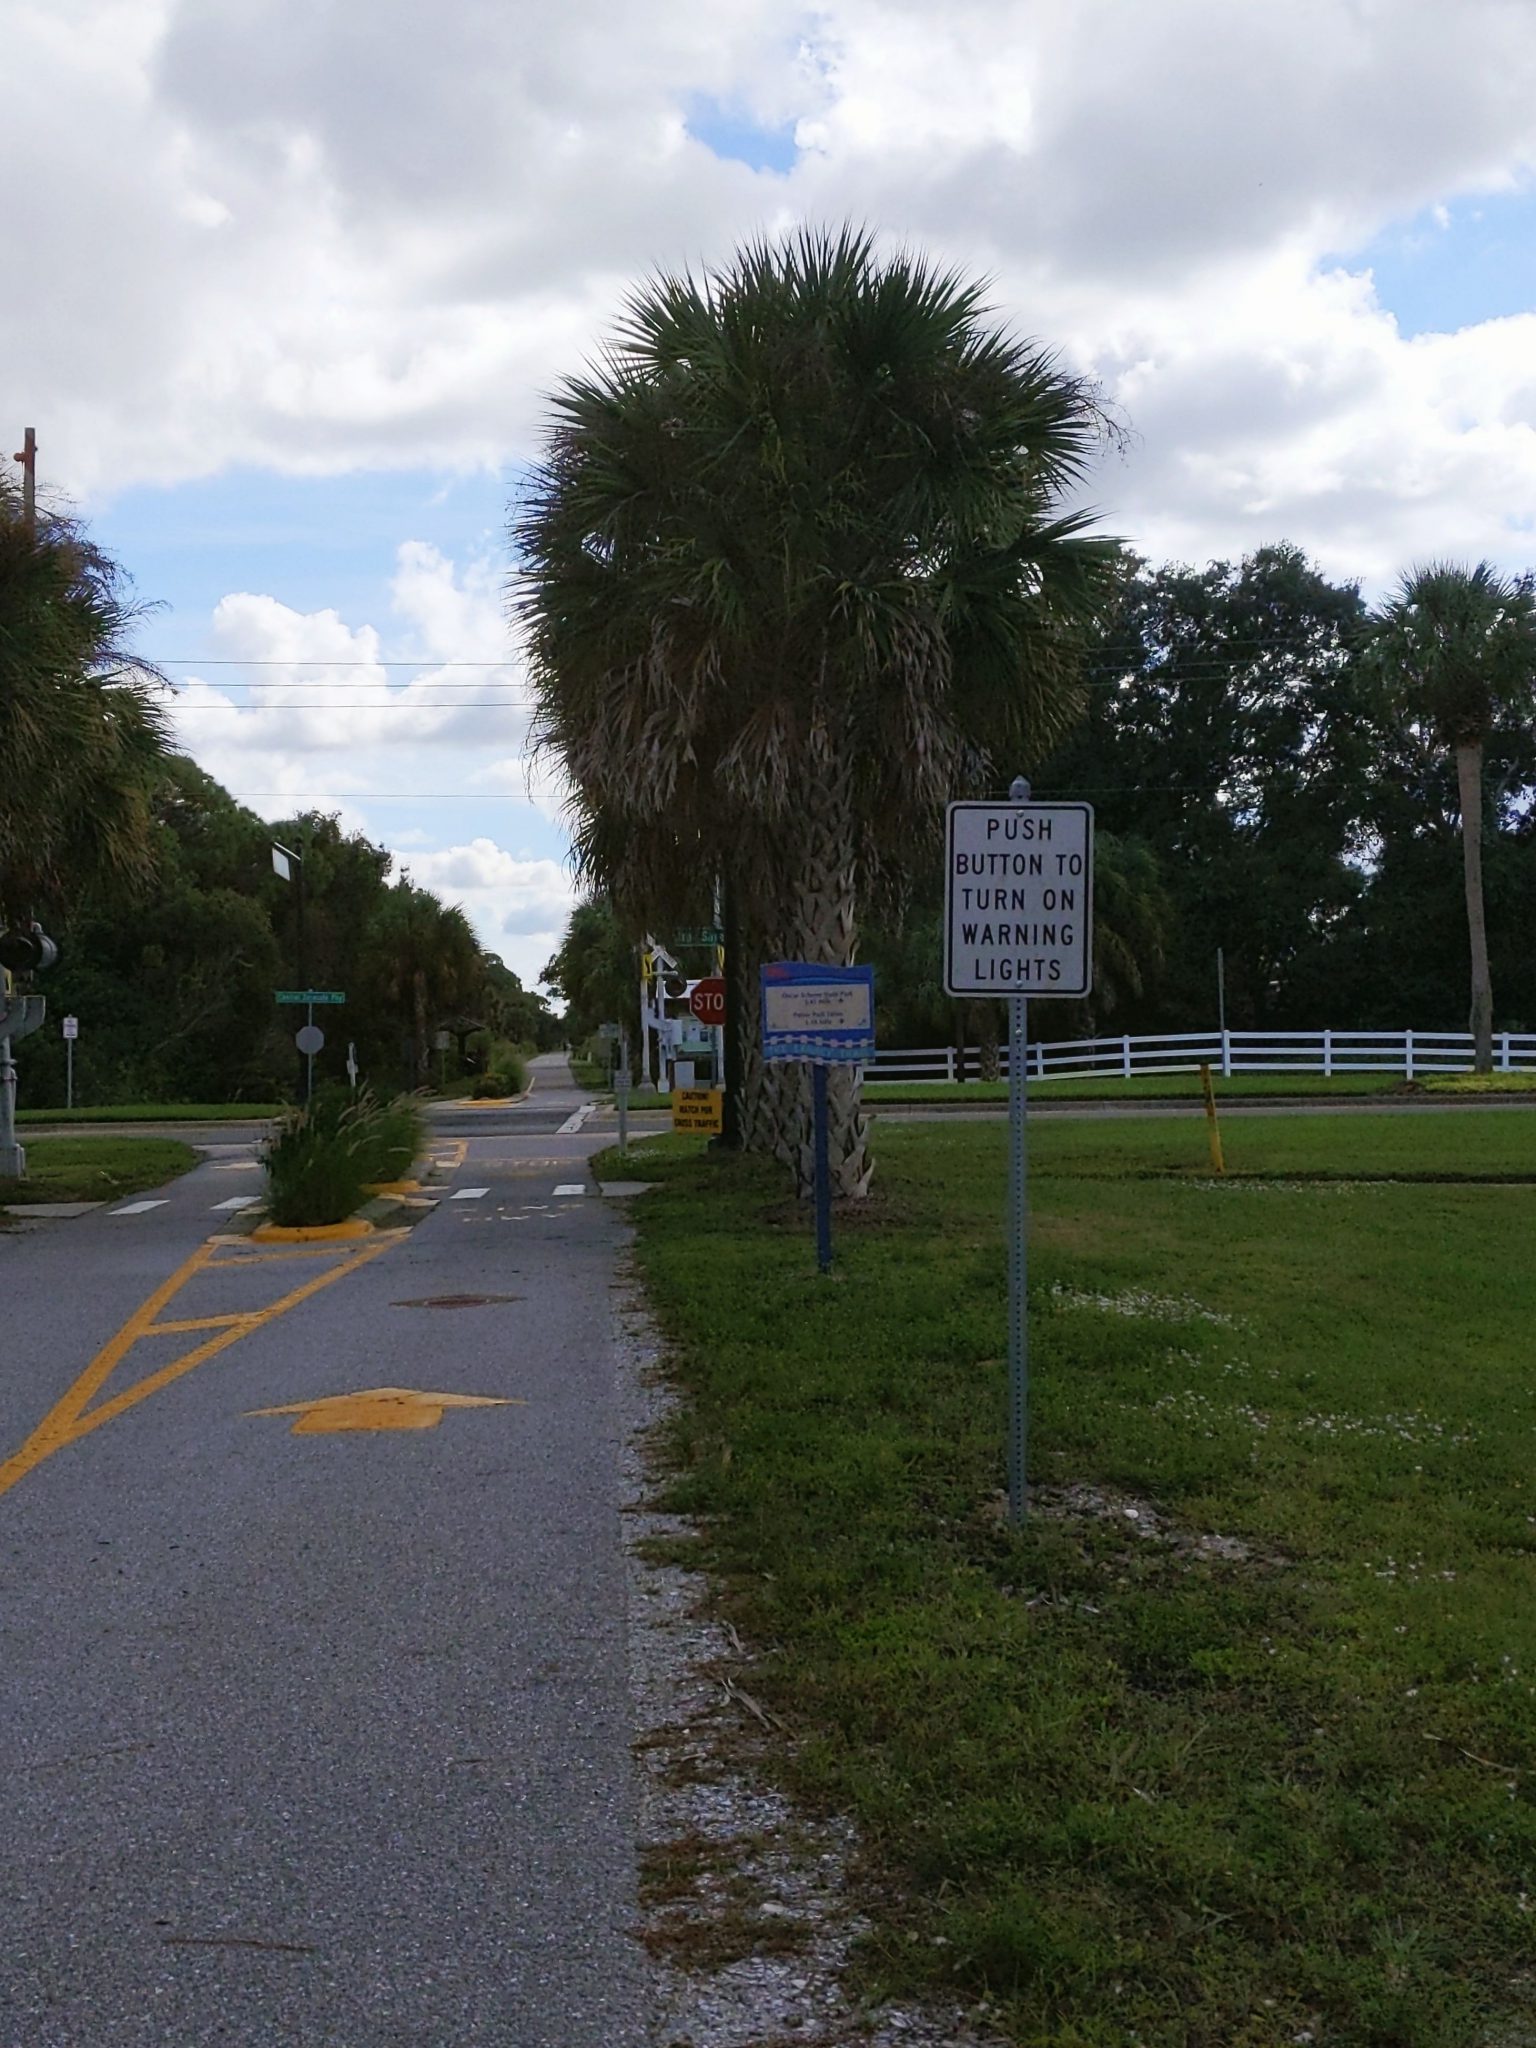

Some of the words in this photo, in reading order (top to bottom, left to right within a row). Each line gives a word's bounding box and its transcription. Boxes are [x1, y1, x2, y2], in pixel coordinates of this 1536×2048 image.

[987, 818, 1052, 841] PUSH
[956, 853, 1042, 876] BUTTON
[1056, 853, 1082, 876] TO
[962, 888, 1025, 911] TURN
[1043, 888, 1075, 911] ON
[962, 923, 1074, 946] WARNING
[975, 958, 1061, 981] LIGHTS
[694, 992, 724, 1011] STO
